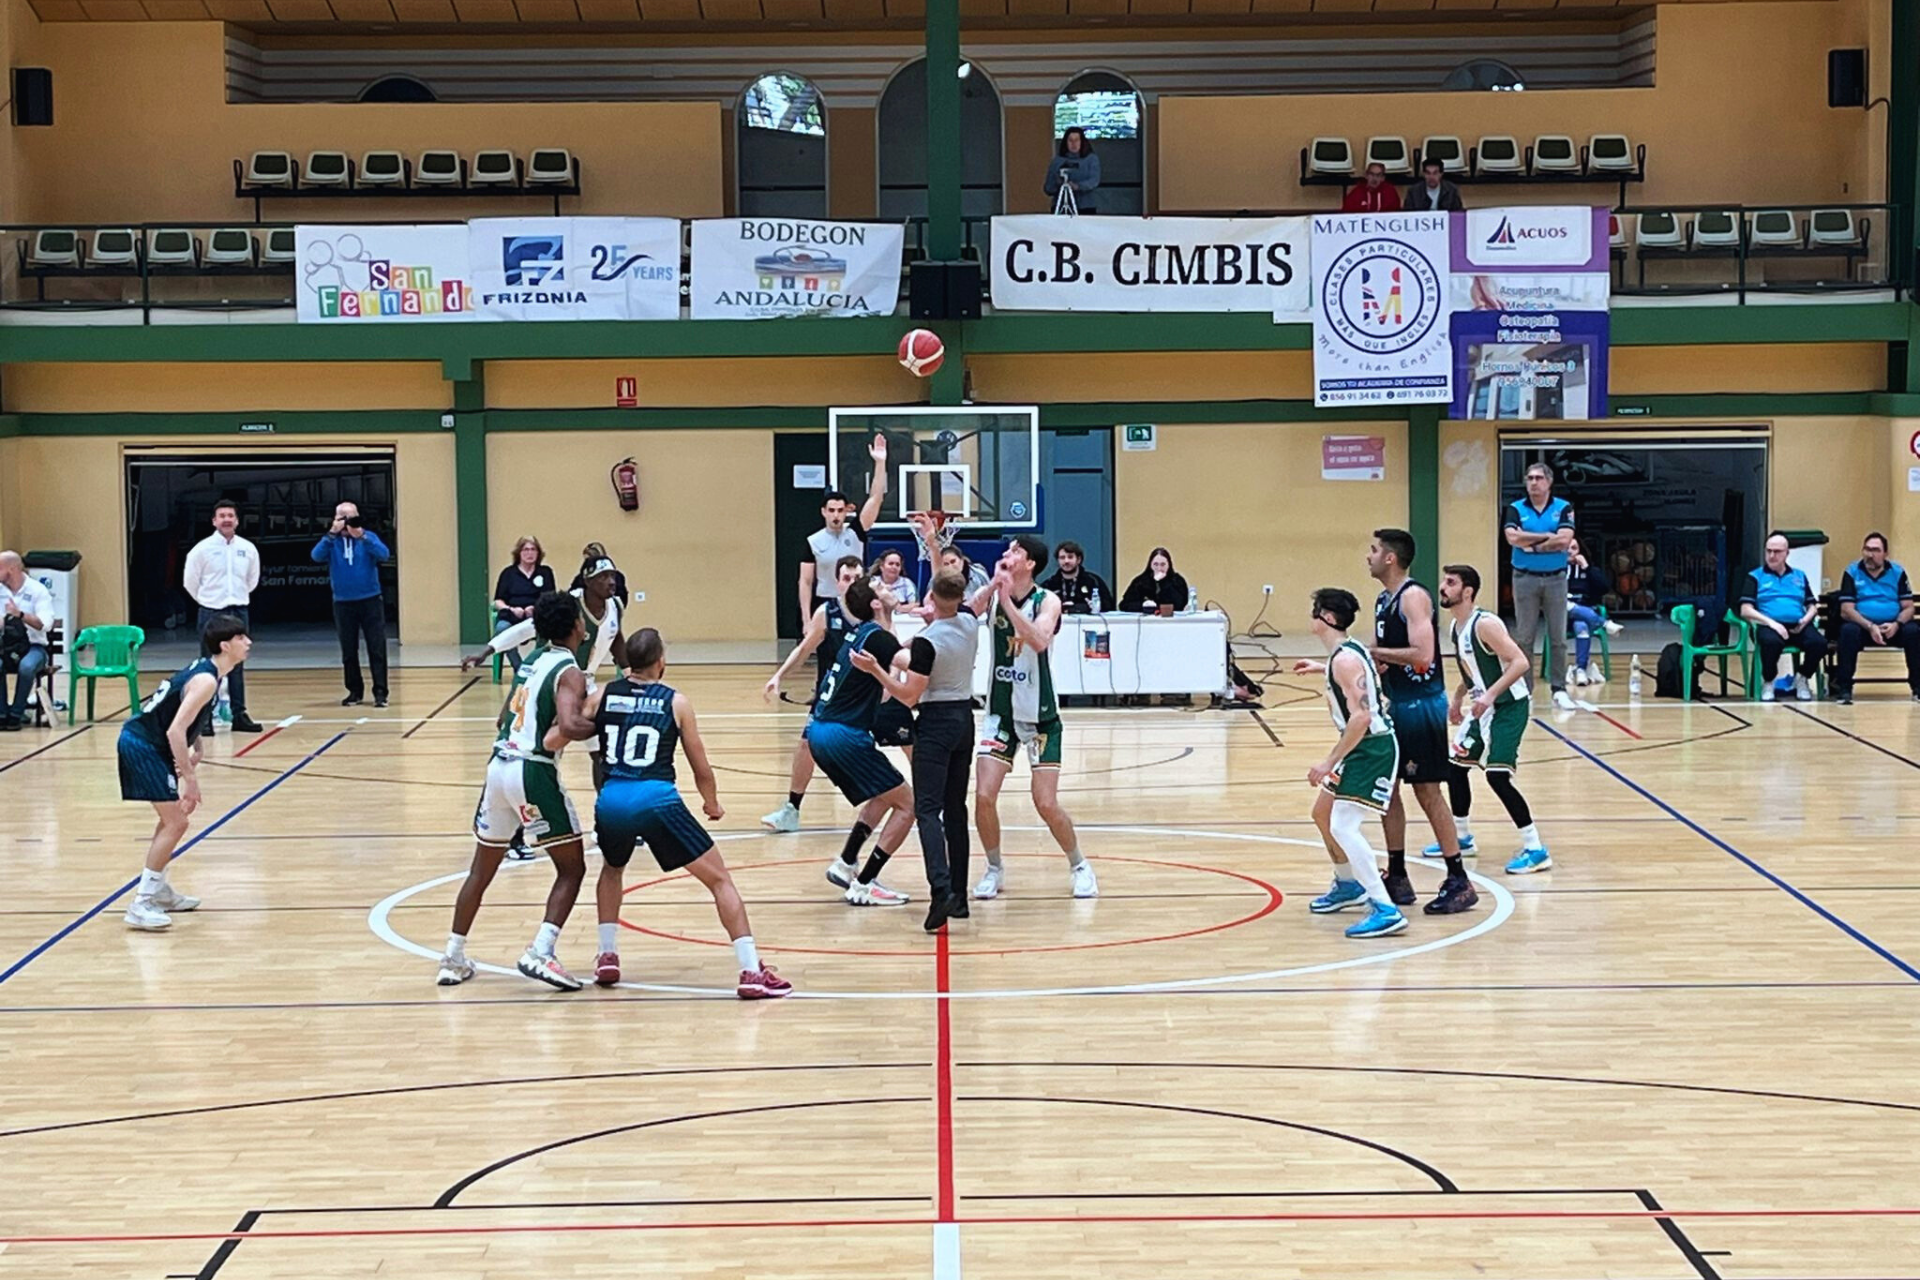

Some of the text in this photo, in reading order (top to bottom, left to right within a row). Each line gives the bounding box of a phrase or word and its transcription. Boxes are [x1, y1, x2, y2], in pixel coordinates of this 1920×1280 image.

[740, 220, 866, 246] BODEGON
[1517, 227, 1568, 238] ACUOS
[633, 266, 674, 281] YEARS
[1005, 239, 1293, 287] C.B. CIMBIS
[1358, 243, 1435, 302] PARTICULARES
[370, 261, 431, 290] San
[483, 292, 588, 306] FRIZONIA
[714, 290, 870, 311] ANDALUCIA
[1364, 341, 1387, 350] QUE
[997, 668, 1027, 682] coto
[604, 724, 661, 768] 10
